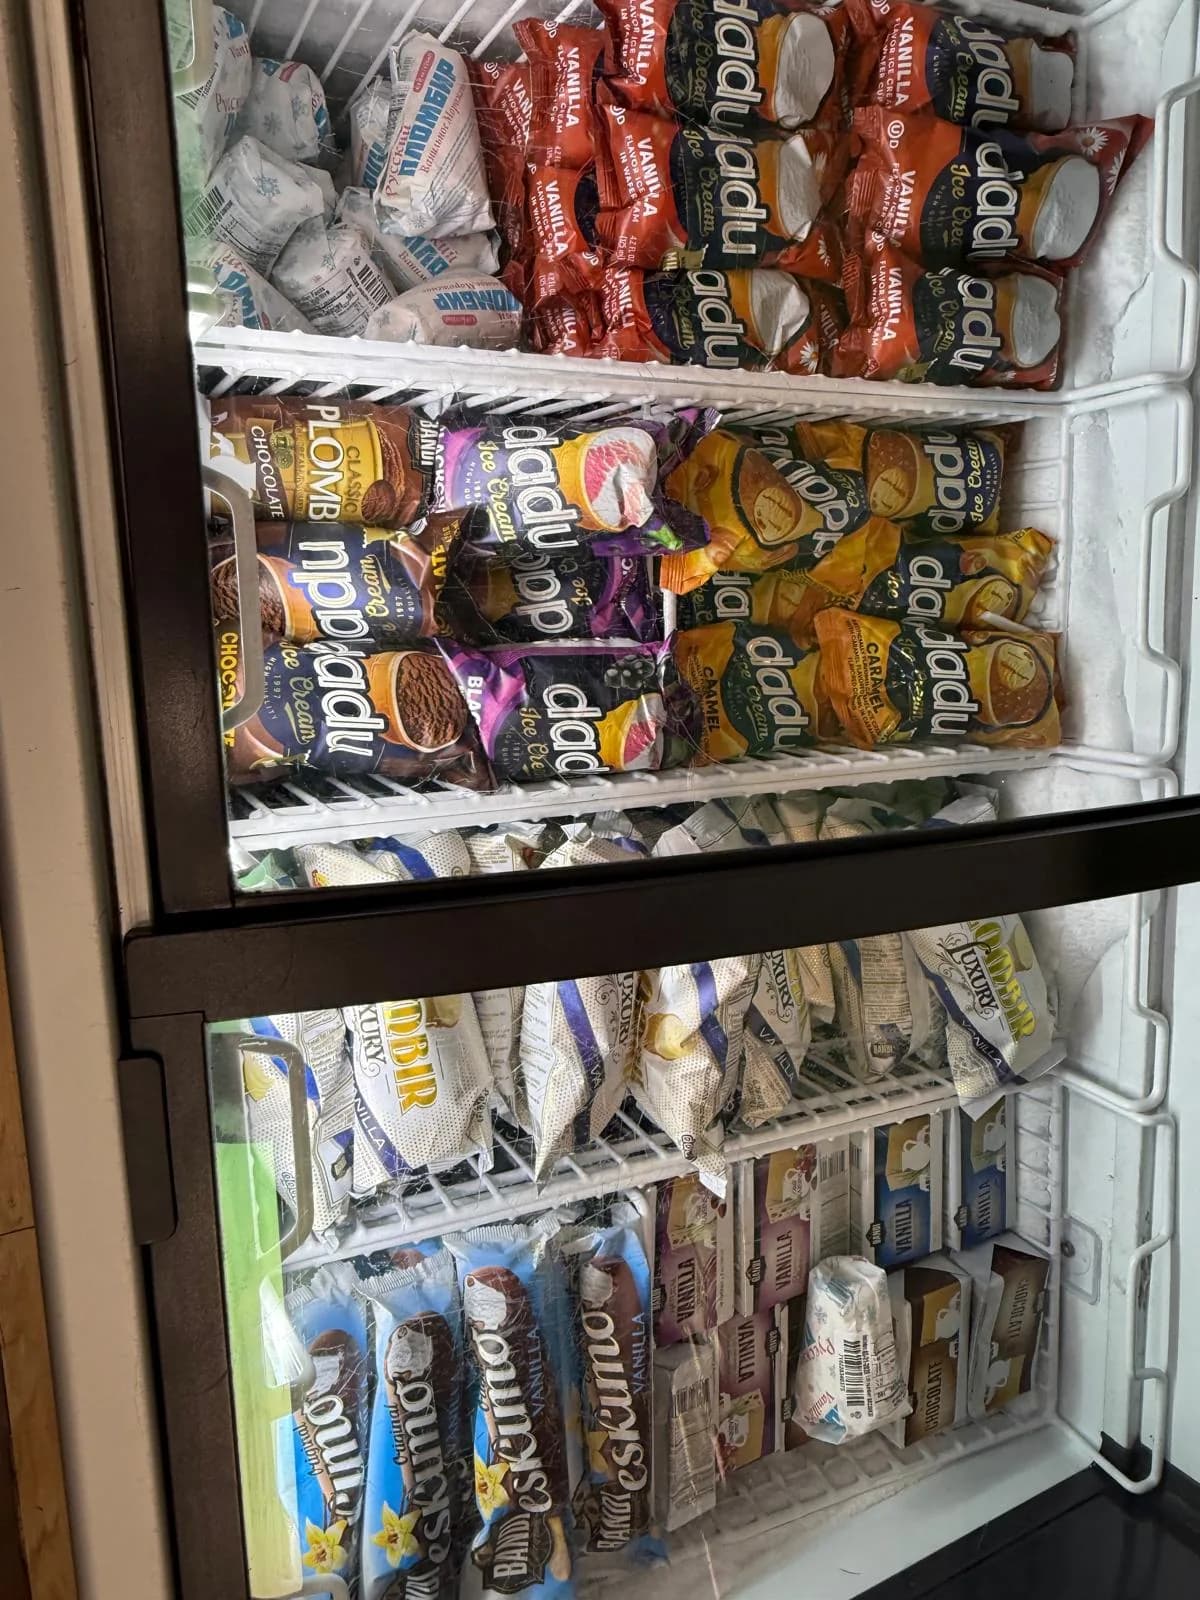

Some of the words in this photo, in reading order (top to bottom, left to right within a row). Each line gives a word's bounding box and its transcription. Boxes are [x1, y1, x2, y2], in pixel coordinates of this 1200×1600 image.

[629, 0, 641, 33] LAVOR
[565, 47, 581, 128] VANILLA
[895, 16, 915, 107] VANILLA
[398, 58, 457, 178] ПЛОМБИР
[682, 129, 706, 159] Ice
[536, 181, 549, 213] FLAVOR
[637, 137, 662, 217] VANILLA
[950, 164, 972, 201] Ice
[546, 180, 569, 256] VANILLA
[663, 251, 679, 272] MIL
[877, 260, 889, 295] FLAVOR
[432, 289, 522, 312] ЛОМБИР
[686, 271, 745, 368] adu
[881, 266, 903, 342] VANILLA
[250, 424, 287, 519] CHOCOLATE
[306, 404, 343, 524] PLOMB
[419, 420, 440, 466] BANDI
[344, 444, 361, 514] CLASSIC
[476, 441, 502, 473] Ice
[489, 477, 519, 543] Cream
[503, 425, 580, 549] dadu
[965, 494, 985, 523] Ice
[292, 541, 372, 640] adu
[358, 555, 390, 618] Cream
[569, 577, 593, 607] Ice
[272, 674, 282, 700] 1997
[280, 642, 300, 669] Ice
[866, 642, 886, 714] CARAMEL
[913, 628, 980, 735] dadu
[287, 677, 317, 745] Cream
[519, 707, 543, 738] Ice
[745, 636, 809, 751] dadu
[542, 683, 611, 775] dad
[618, 973, 638, 1046] UXURY
[766, 951, 795, 1011] UXURY
[968, 920, 1038, 1042] OMBIR
[758, 1026, 796, 1081] VAILLA
[354, 1098, 387, 1152] NILLA
[895, 1199, 914, 1257] VANILLA
[977, 1182, 995, 1238] VANILLA
[676, 1257, 697, 1324] VANILLA
[775, 1230, 794, 1292] VANILLA
[525, 1325, 548, 1417] VANILLA
[630, 1312, 649, 1395] VANILLA
[737, 1319, 756, 1384] VANILLA
[470, 1327, 554, 1513] eskimo
[581, 1309, 649, 1492] eskimo
[924, 1361, 943, 1434] CHOCOLATE
[292, 1421, 324, 1477] Original
[383, 1404, 407, 1467] Original
[394, 1381, 452, 1564] eskimo
[493, 1512, 531, 1579] BANDI
[597, 1492, 634, 1548] BANDI
